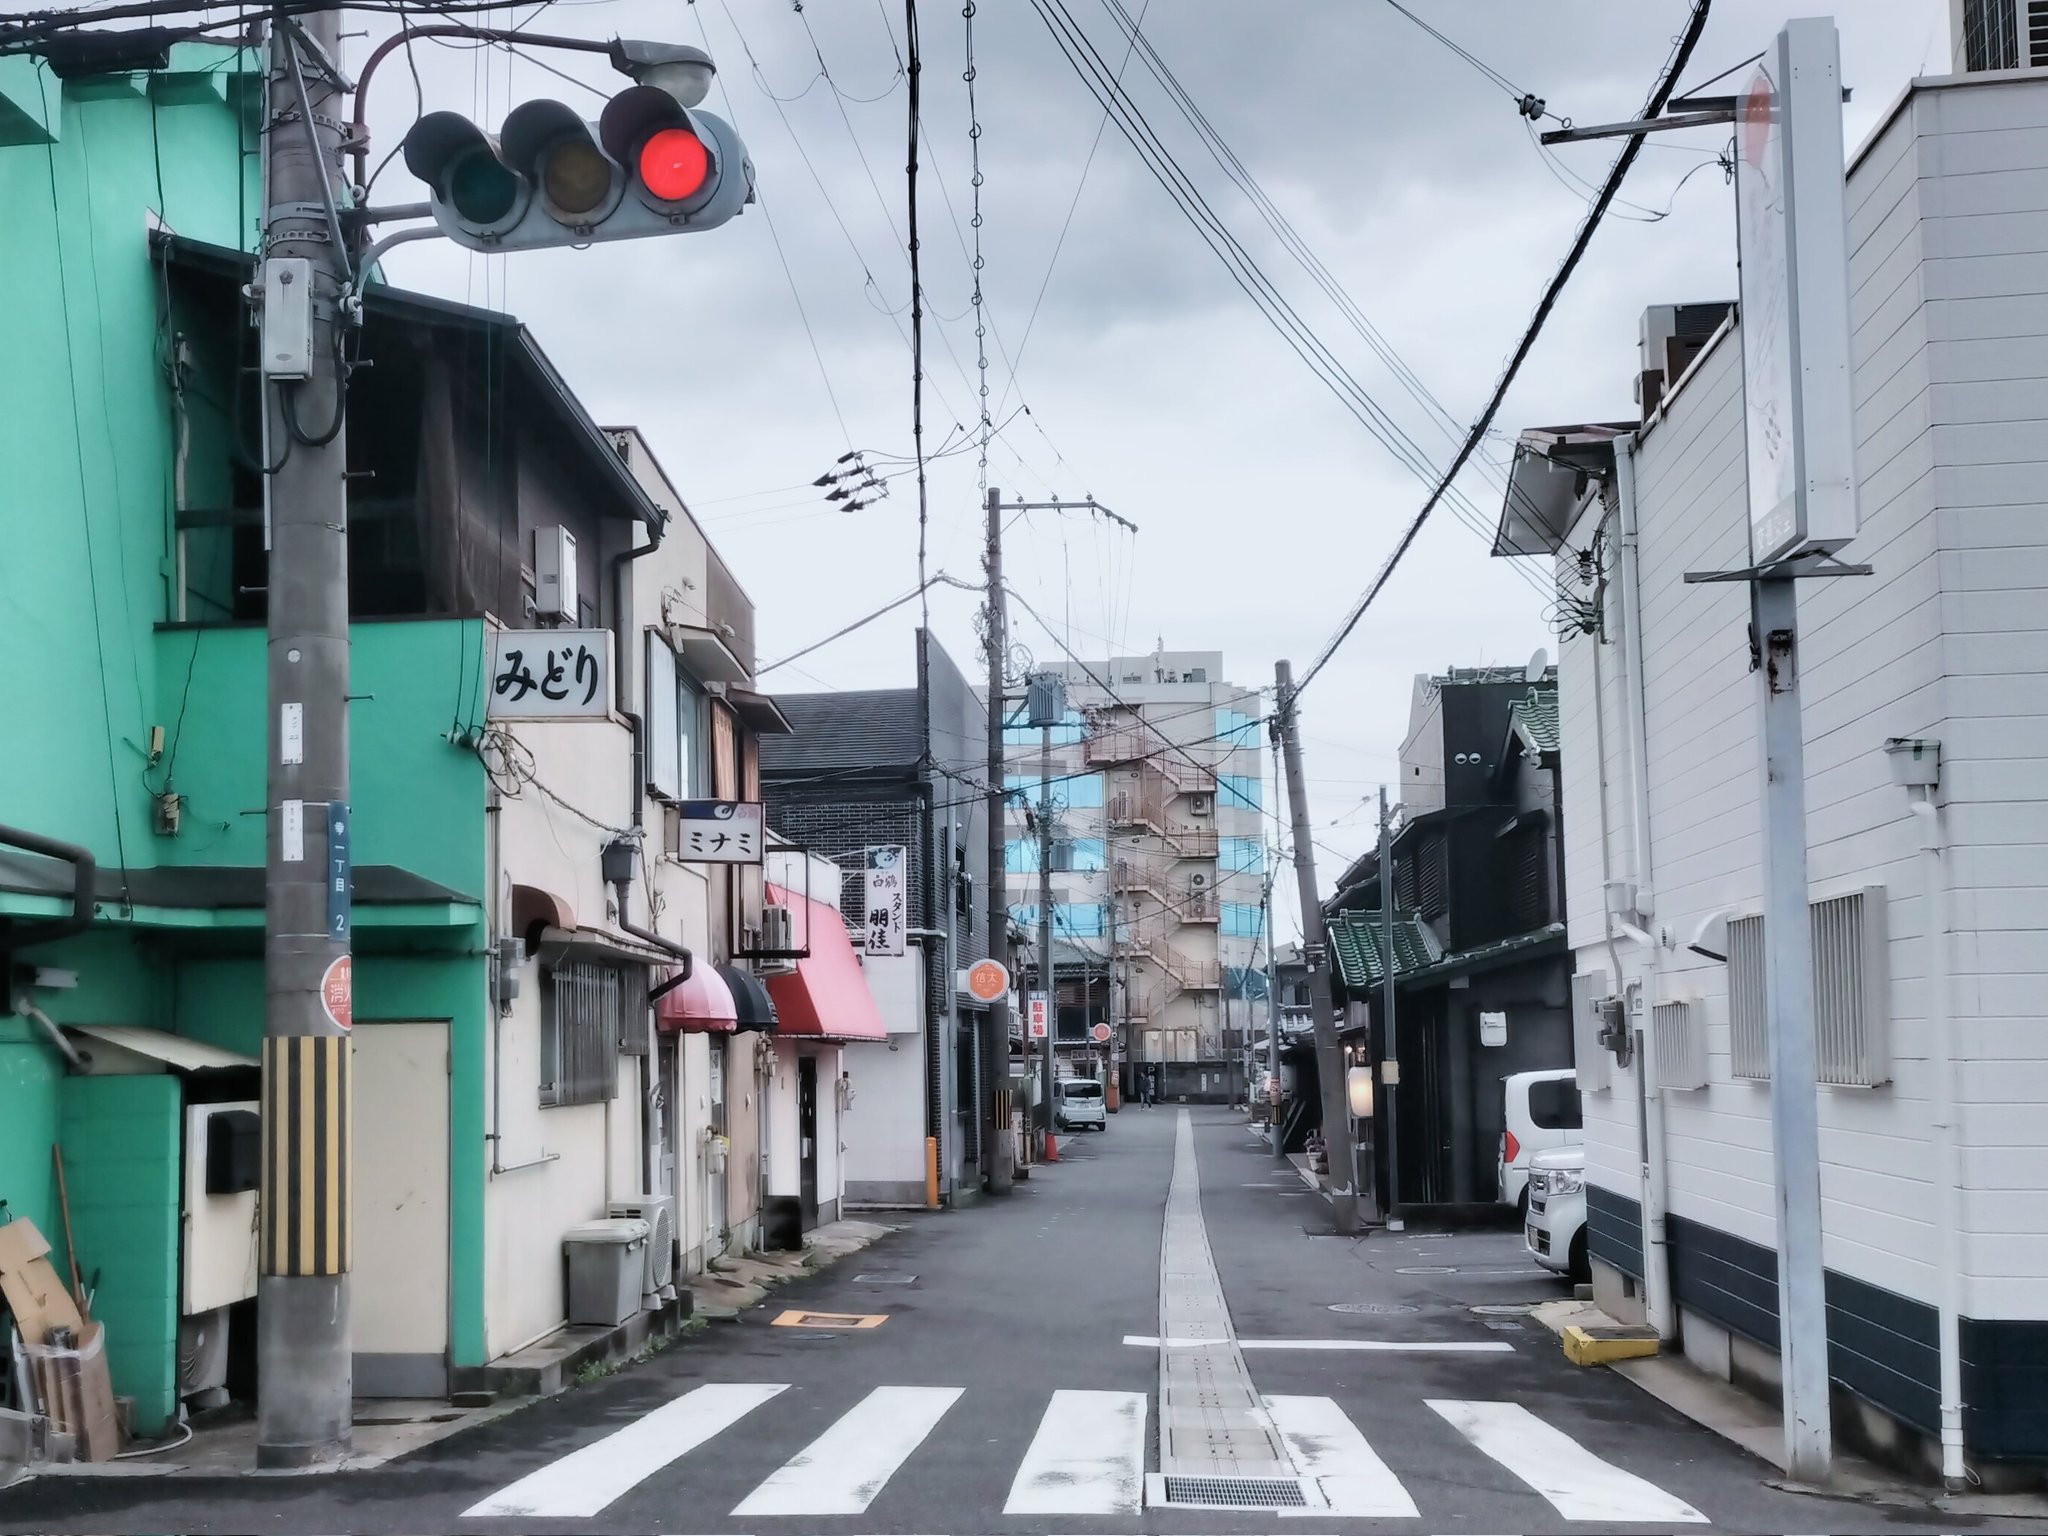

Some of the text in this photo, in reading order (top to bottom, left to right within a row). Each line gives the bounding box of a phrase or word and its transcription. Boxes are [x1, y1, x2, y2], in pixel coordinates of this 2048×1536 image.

[496, 644, 598, 706] みどり
[690, 831, 751, 854] ミナミ
[334, 821, 345, 931] 幸一丁目 2
[892, 892, 902, 934] スタンド
[1032, 1001, 1044, 1036] 駐車場
